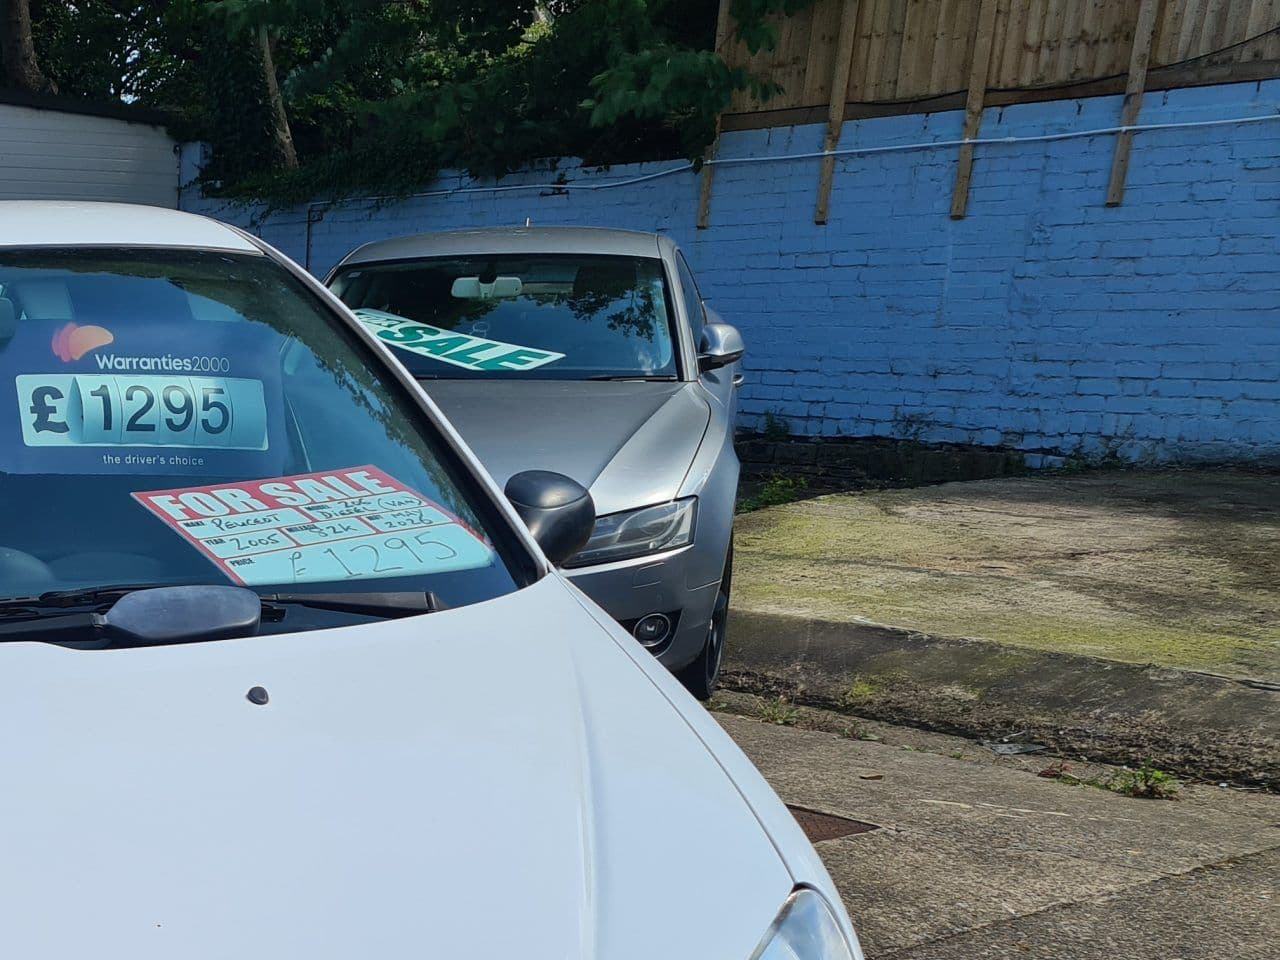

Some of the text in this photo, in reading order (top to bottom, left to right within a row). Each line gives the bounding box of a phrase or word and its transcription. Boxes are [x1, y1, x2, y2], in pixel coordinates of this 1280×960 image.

[376, 325, 552, 371] SALE
[95, 353, 231, 374] Warranties2000
[103, 454, 204, 467] the driver's choice
[149, 470, 396, 521] FOR SALE
[229, 533, 280, 552] 2005
[230, 558, 256, 568] PRICE
